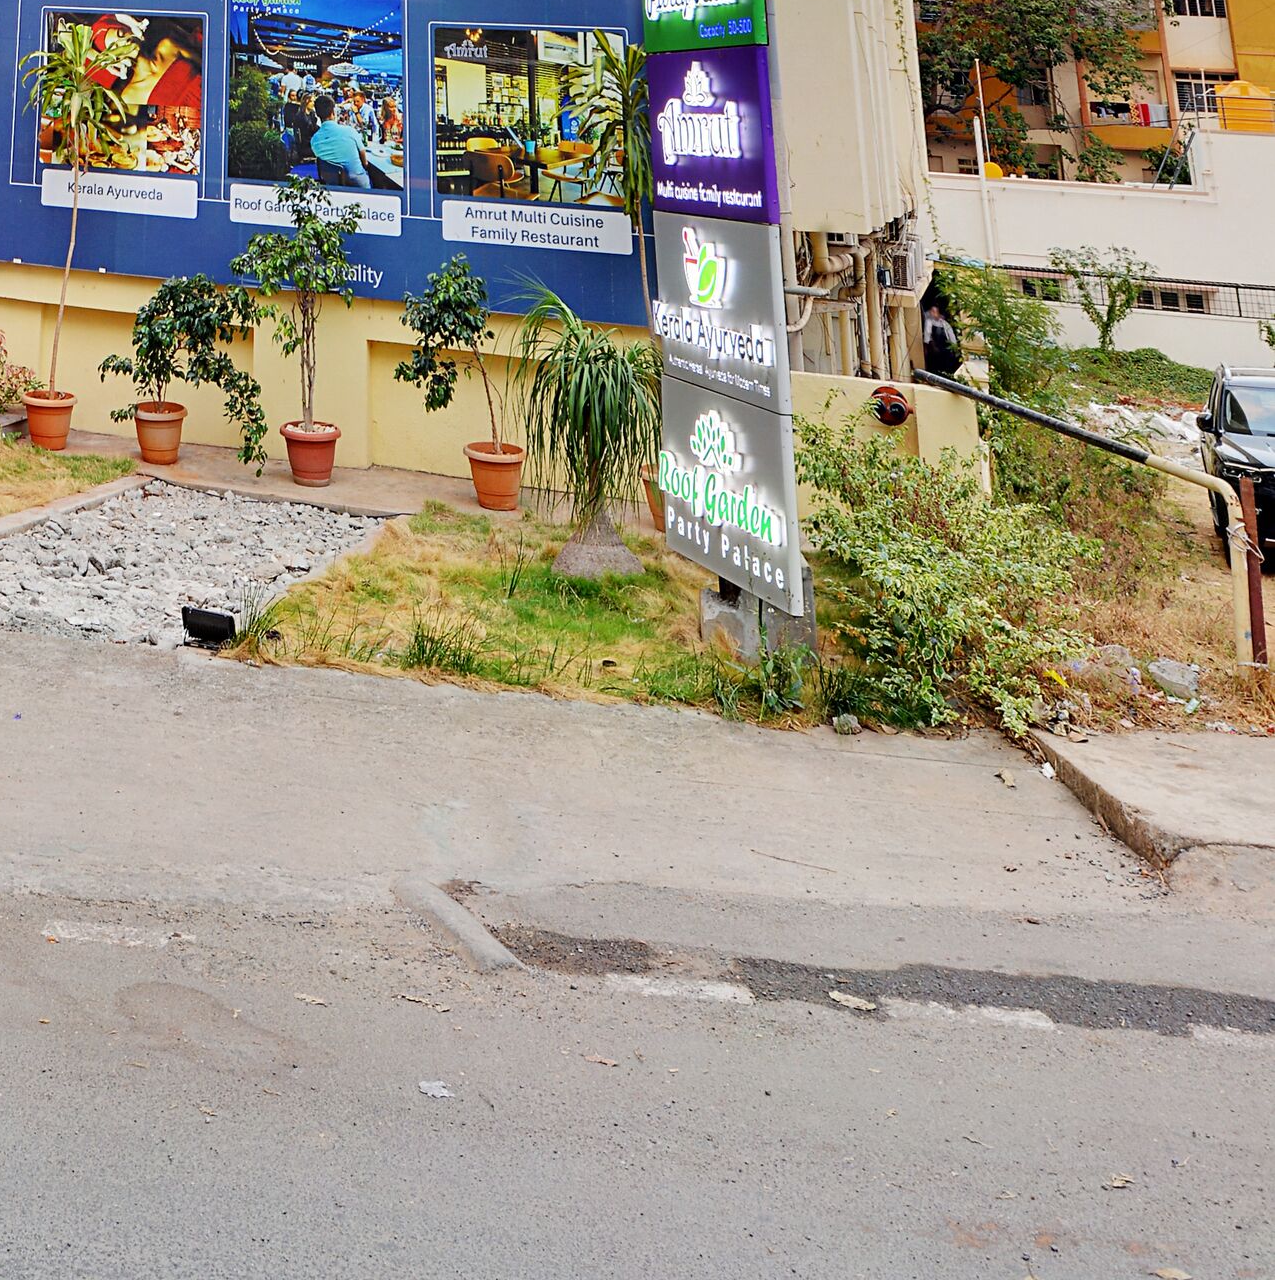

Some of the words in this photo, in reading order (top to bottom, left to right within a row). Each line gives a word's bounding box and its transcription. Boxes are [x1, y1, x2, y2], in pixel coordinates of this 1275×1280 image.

[234, 5, 260, 13] Party
[266, 6, 300, 14] Palace
[444, 43, 488, 58] Amrut
[657, 100, 742, 165] Amrut
[67, 182, 104, 195] Kerala
[106, 185, 163, 201] Ayurveda
[657, 180, 675, 198] Multi
[675, 182, 699, 201] cuisine
[699, 182, 722, 208] family
[722, 188, 762, 208] restaurant
[234, 198, 262, 211] Roof
[465, 207, 508, 222] Amrut
[511, 211, 547, 225] Multi
[550, 213, 604, 229] Cuisine
[471, 226, 518, 244] Family
[521, 230, 599, 248] Restaurant
[652, 300, 694, 343] Kerala
[697, 312, 767, 364] Ayurveda
[658, 452, 703, 518] Roof
[704, 472, 777, 544] Garden
[667, 505, 710, 555] Party
[721, 533, 785, 590] Palace
